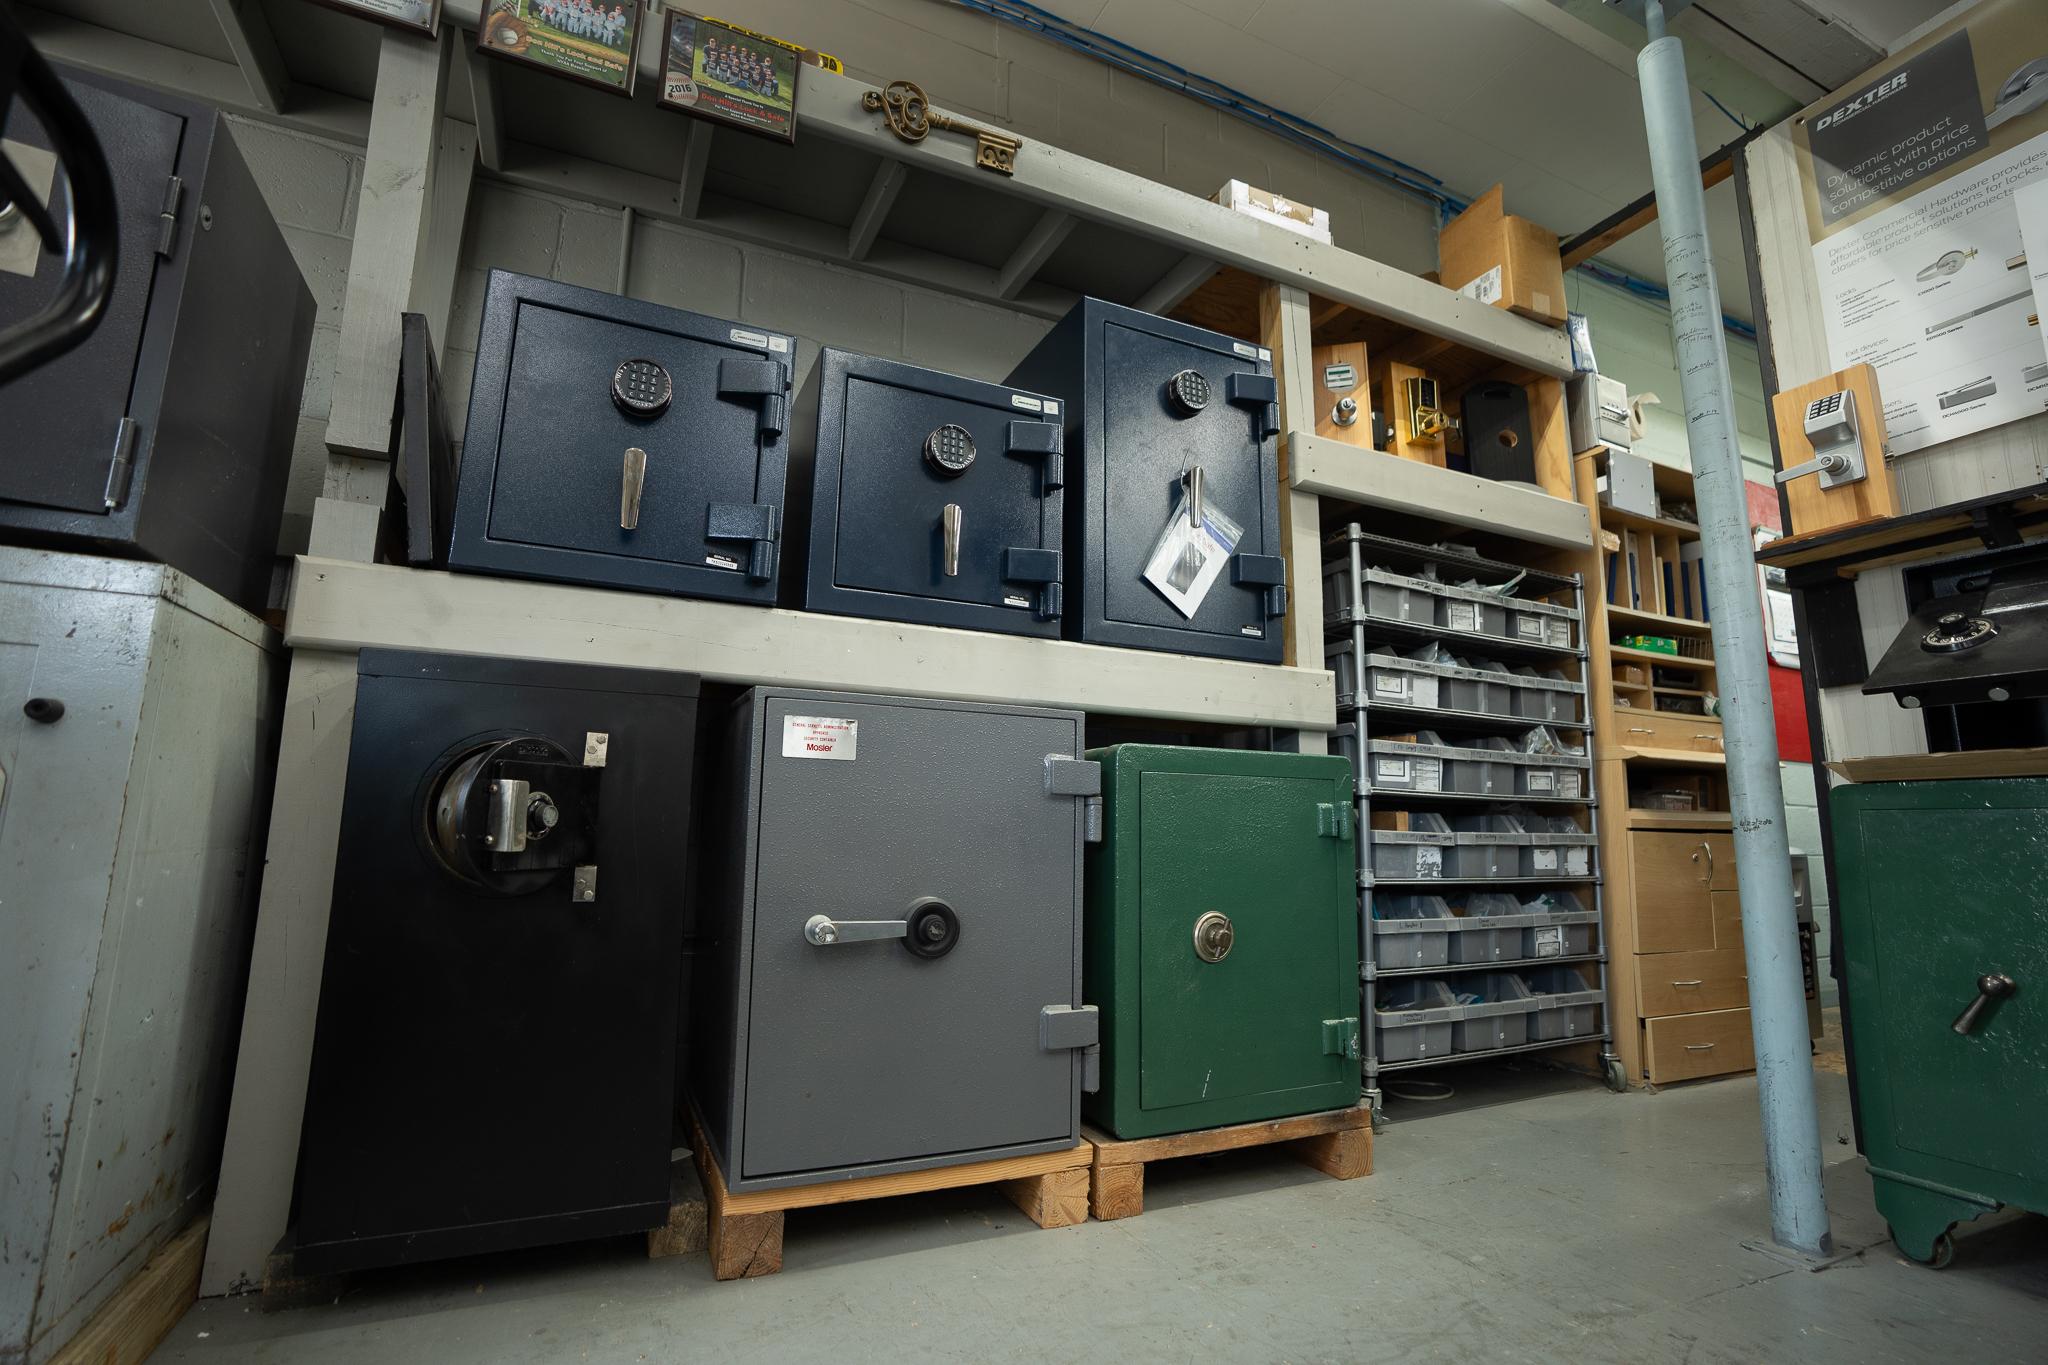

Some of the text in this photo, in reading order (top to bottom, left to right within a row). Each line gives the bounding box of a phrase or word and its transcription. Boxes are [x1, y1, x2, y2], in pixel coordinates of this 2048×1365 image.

[668, 84, 692, 93] 2016
[701, 92, 717, 103] Don
[1816, 72, 1907, 131] DEXTER
[1832, 104, 1871, 127] COMMERCIAL
[1827, 116, 1952, 188] Dynamic product
[1830, 124, 1969, 202] solutions with price
[1832, 136, 1977, 214] competitive options
[1828, 150, 2047, 258] Dexter Commercial Hardware provides
[1830, 165, 2043, 266] affordable product solutions for locks,
[1831, 256, 1867, 275] closers
[1868, 247, 1882, 258] for
[1884, 235, 1911, 252] price
[1913, 211, 1963, 239] sensitive
[806, 743, 833, 752] Mosler
